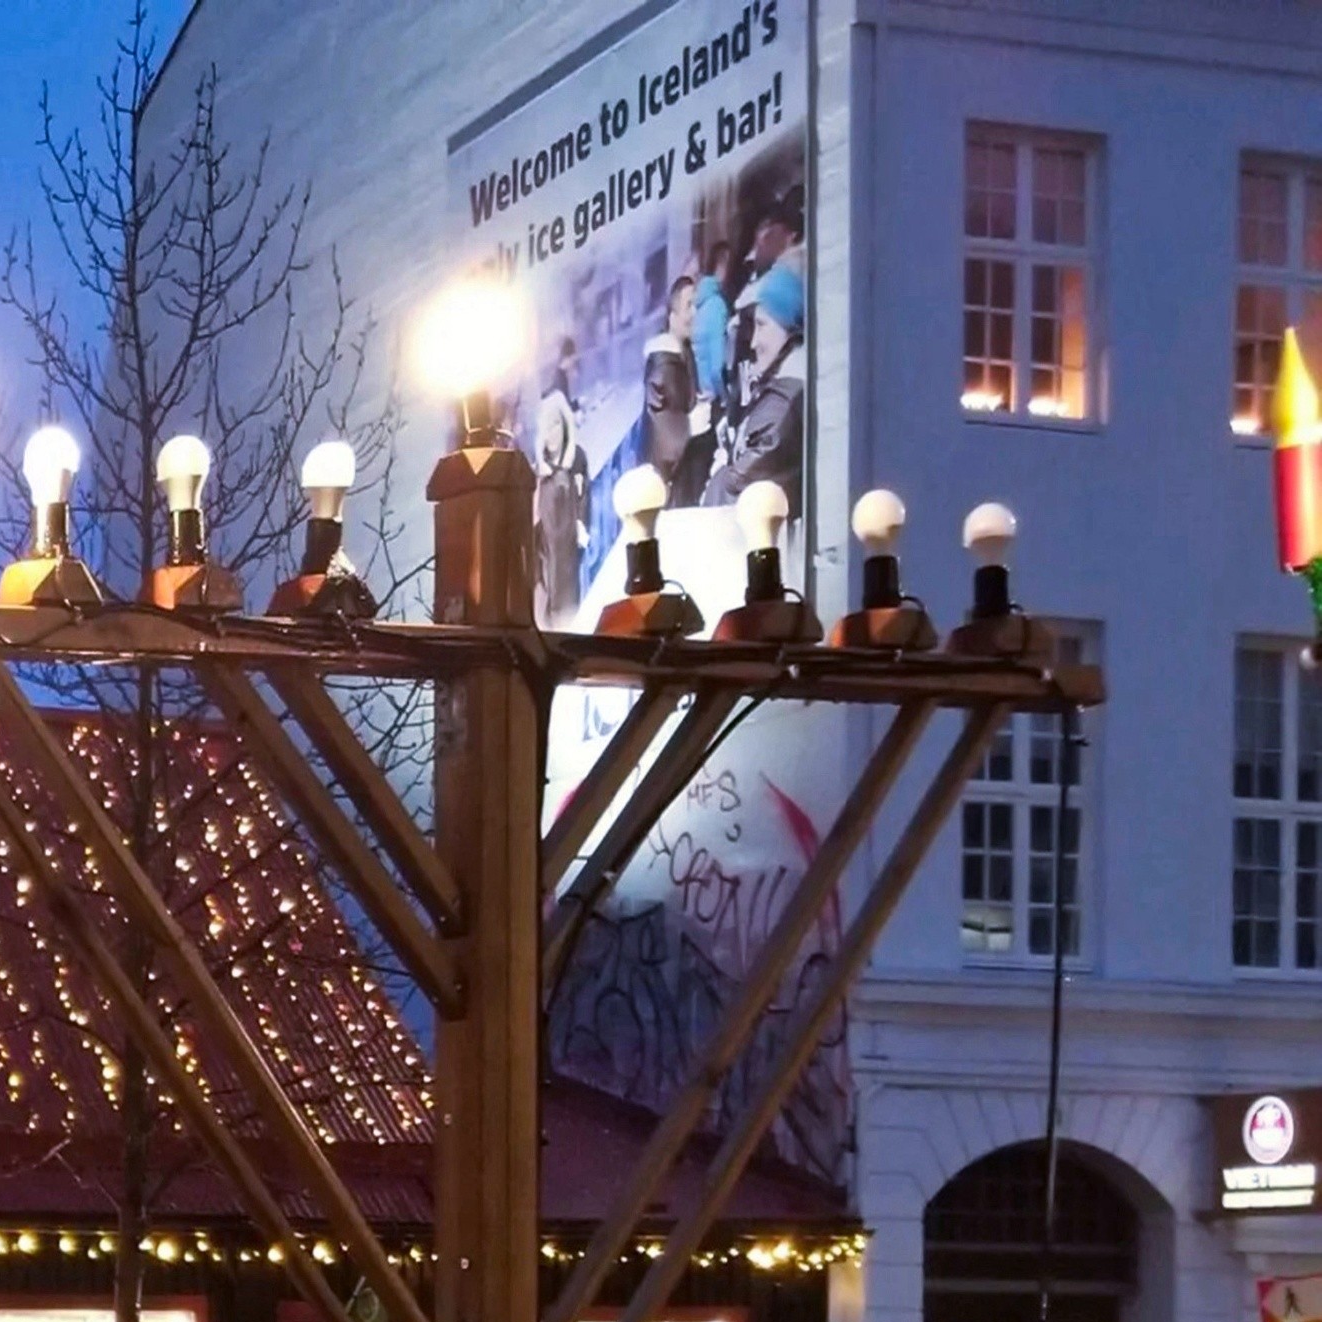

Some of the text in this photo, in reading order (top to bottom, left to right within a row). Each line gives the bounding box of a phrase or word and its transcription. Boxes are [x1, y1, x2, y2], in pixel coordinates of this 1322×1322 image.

[469, 0, 778, 228] Welcome to Iceland's
[528, 215, 565, 269] ice
[573, 147, 675, 250] gallery
[684, 121, 707, 175] &
[717, 71, 783, 159] bar!
